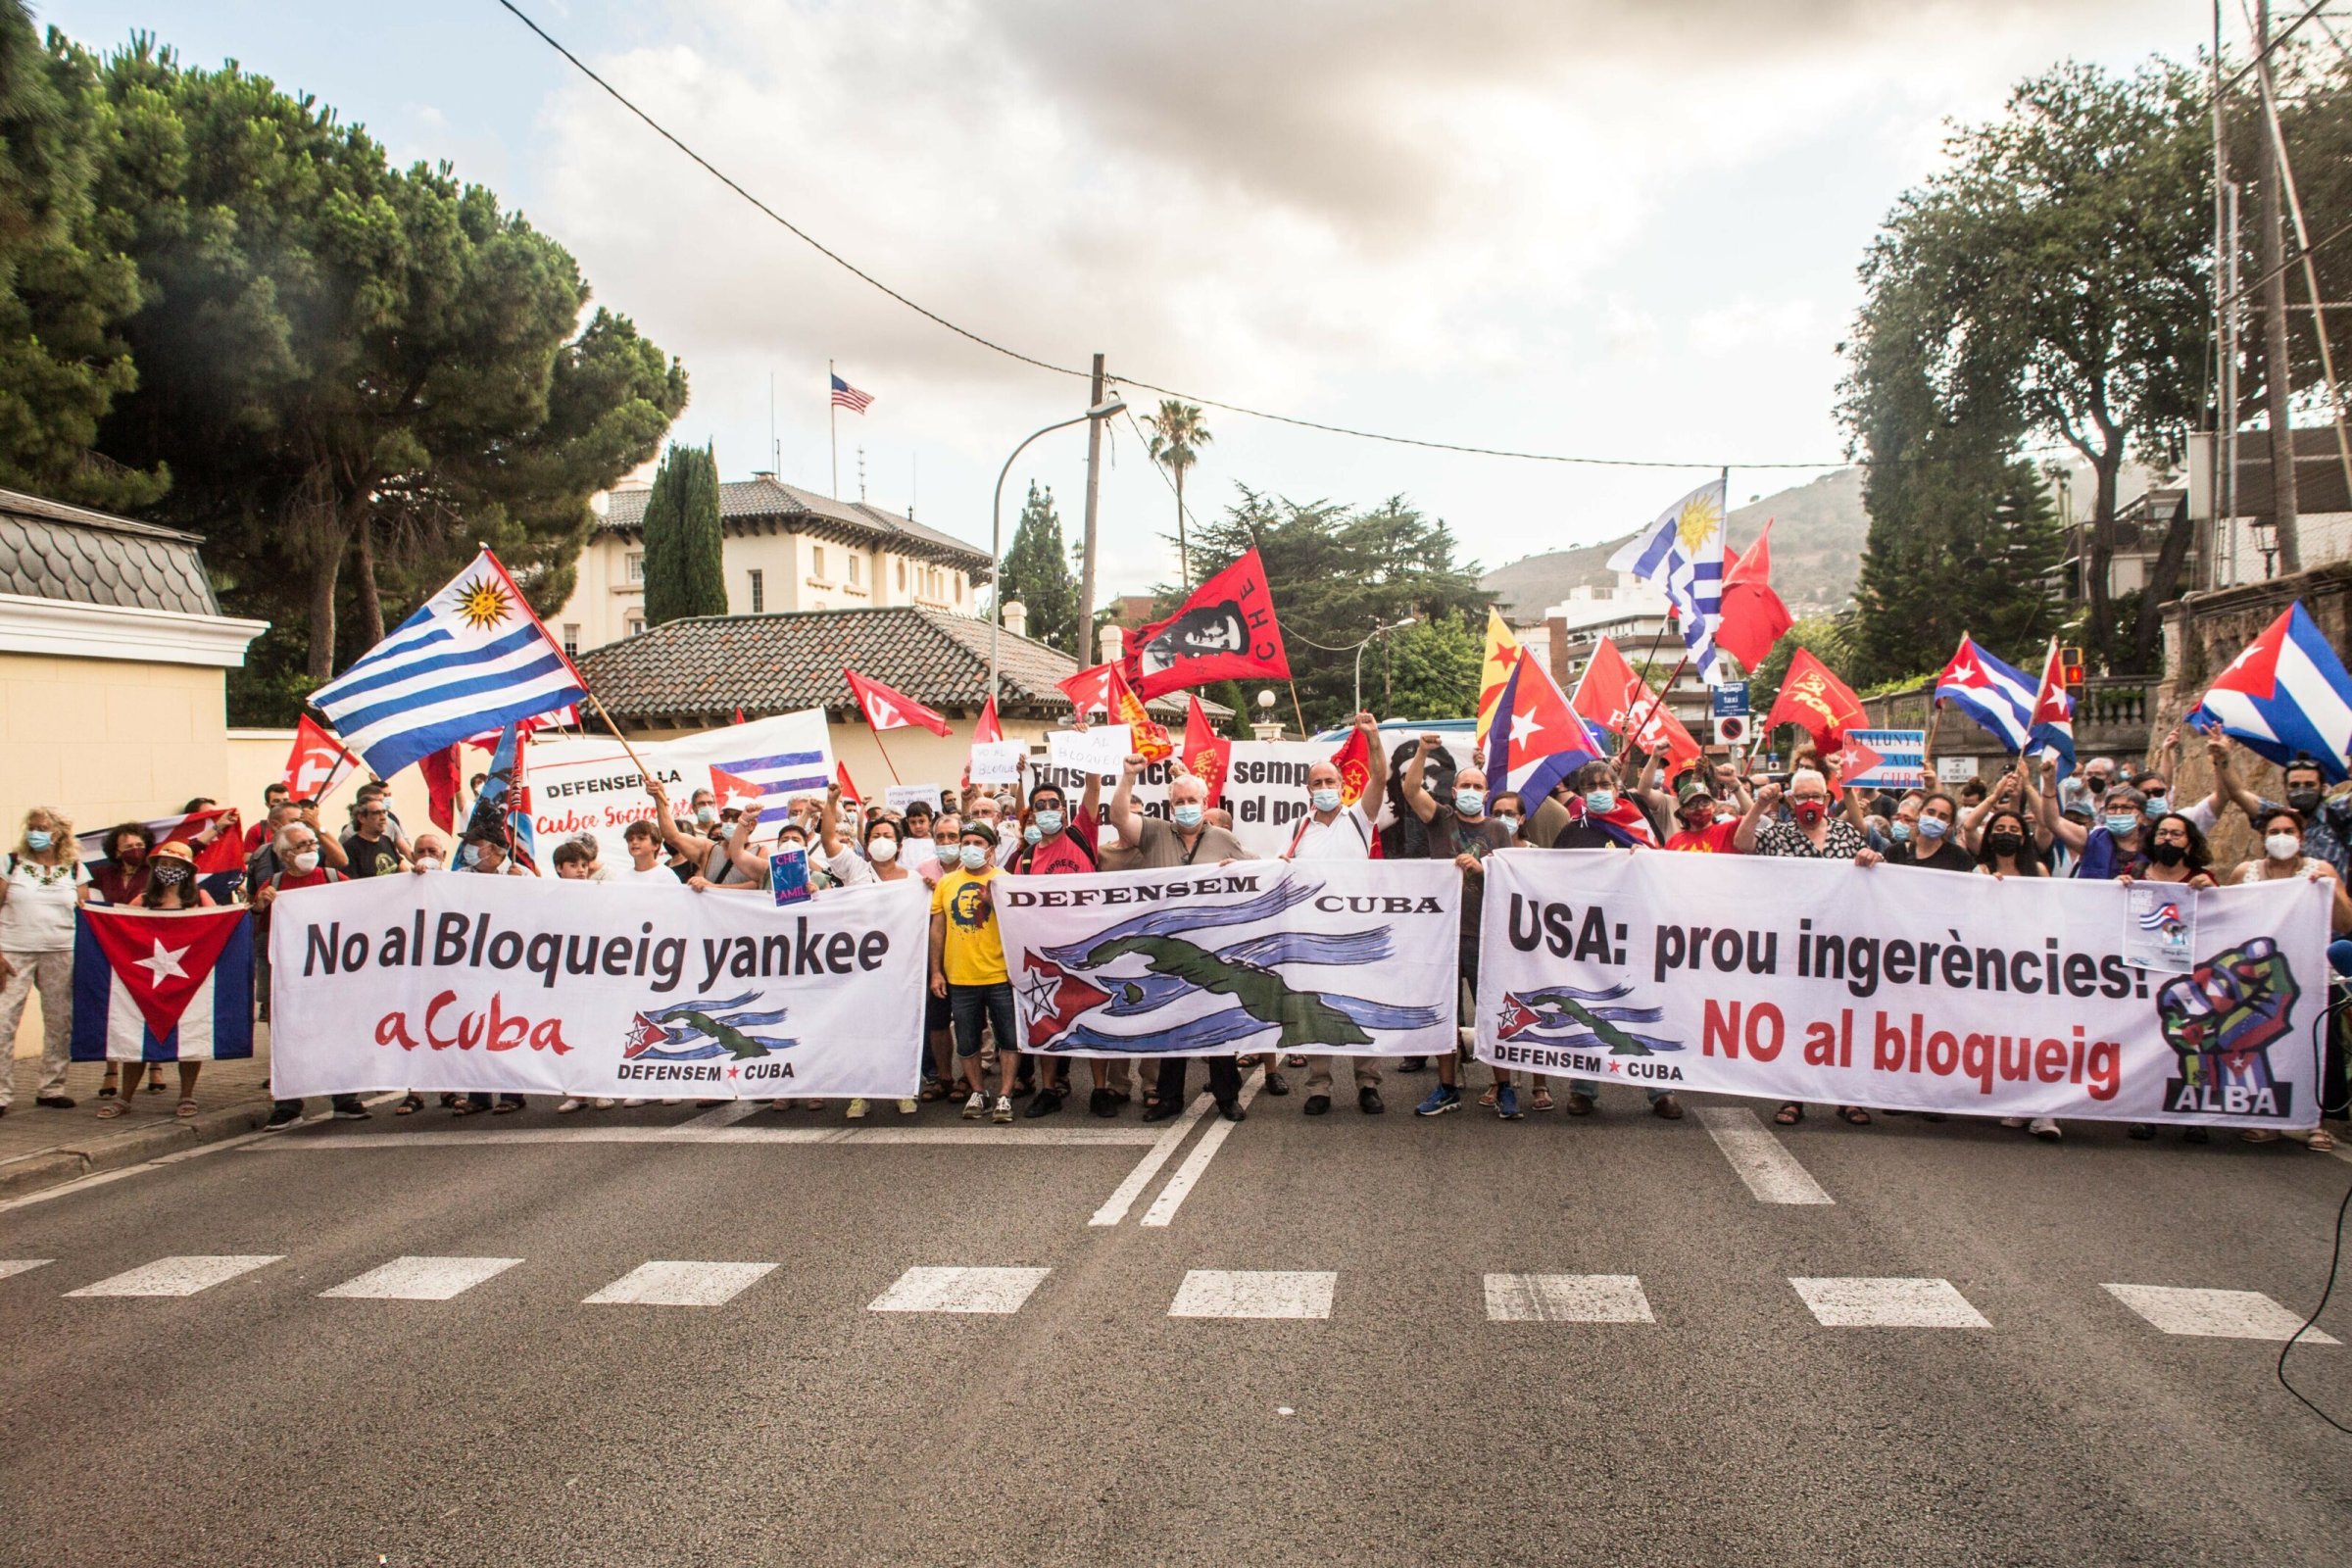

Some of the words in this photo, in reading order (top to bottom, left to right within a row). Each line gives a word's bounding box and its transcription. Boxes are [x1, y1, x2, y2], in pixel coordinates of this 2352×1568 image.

[1239, 577, 1277, 662] CHE
[1843, 733, 1922, 747] CATALUNYA
[978, 762, 1016, 775] BLOQUE
[1233, 759, 1310, 788] semp
[1890, 754, 1923, 767] AMB
[657, 769, 683, 785] LA
[536, 808, 599, 835] Cuba
[1240, 795, 1266, 823] el
[775, 851, 799, 865] CHE
[773, 885, 810, 900] AMIL
[1006, 874, 1261, 907] DEFENSEM
[1314, 896, 1446, 913] CUBA
[303, 922, 369, 977] No
[378, 908, 425, 968] al
[433, 911, 687, 993] Bloqueig
[698, 915, 889, 994] yankee
[1508, 893, 1628, 966] USA:
[1654, 925, 1778, 984] prou
[374, 1011, 418, 1052] a
[424, 989, 573, 1055] Cuba
[1494, 1045, 1602, 1073] DEFENSEM
[1627, 1061, 1684, 1081] CUBA
[1702, 998, 1786, 1062] NO
[1803, 1007, 1854, 1067] al
[1873, 1010, 2122, 1101] bloqueig
[617, 1064, 722, 1082] DEFENSEM
[744, 1061, 796, 1080] CUBA
[2174, 1084, 2278, 1115] ALBA
